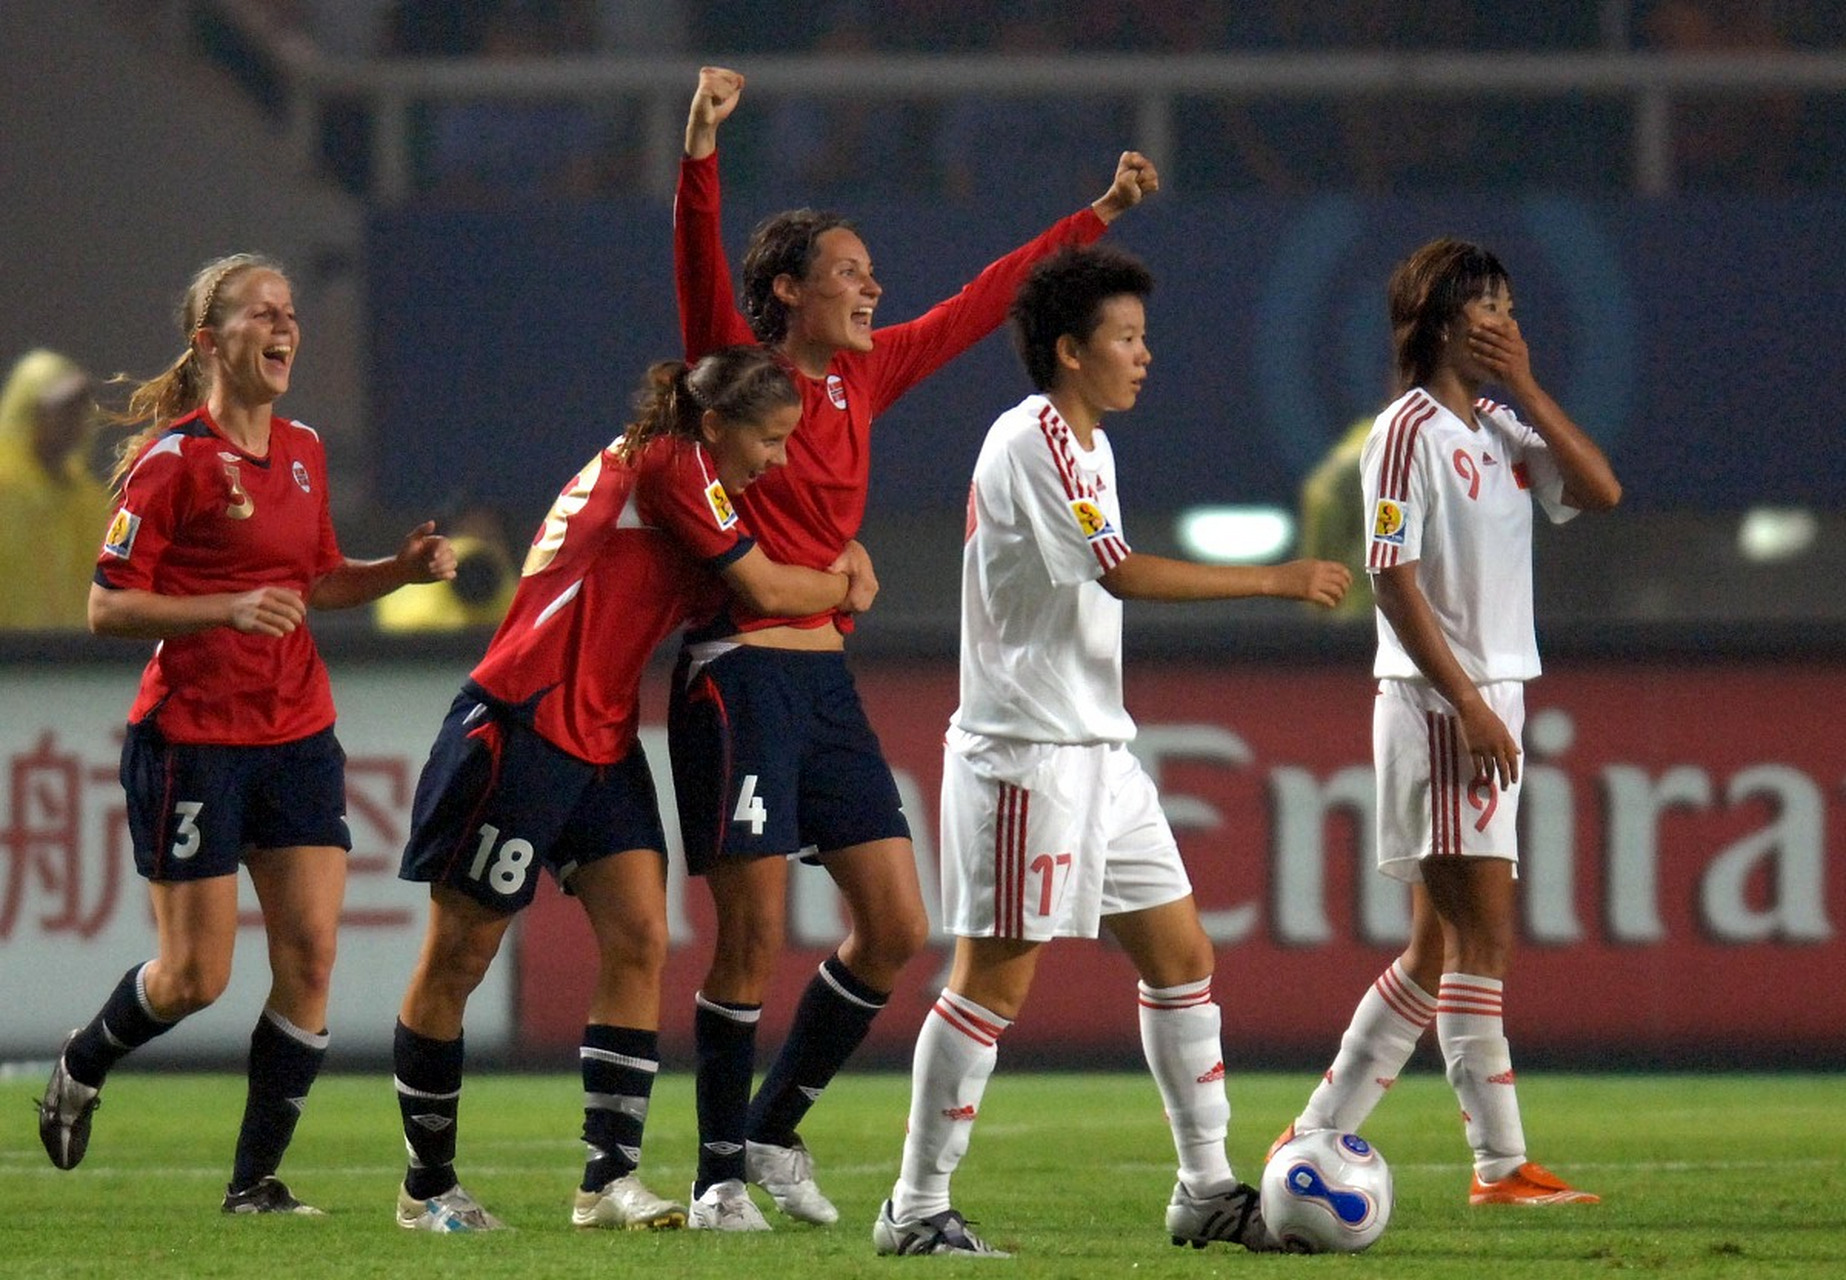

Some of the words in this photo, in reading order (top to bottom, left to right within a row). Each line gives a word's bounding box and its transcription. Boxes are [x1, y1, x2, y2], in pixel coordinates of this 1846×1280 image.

[224, 464, 254, 519] 3
[1453, 448, 1480, 501] 9
[172, 801, 204, 859] 3
[733, 775, 767, 835] 4
[1467, 775, 1498, 833] 9
[469, 822, 534, 895] 18
[1030, 853, 1072, 916] 17
